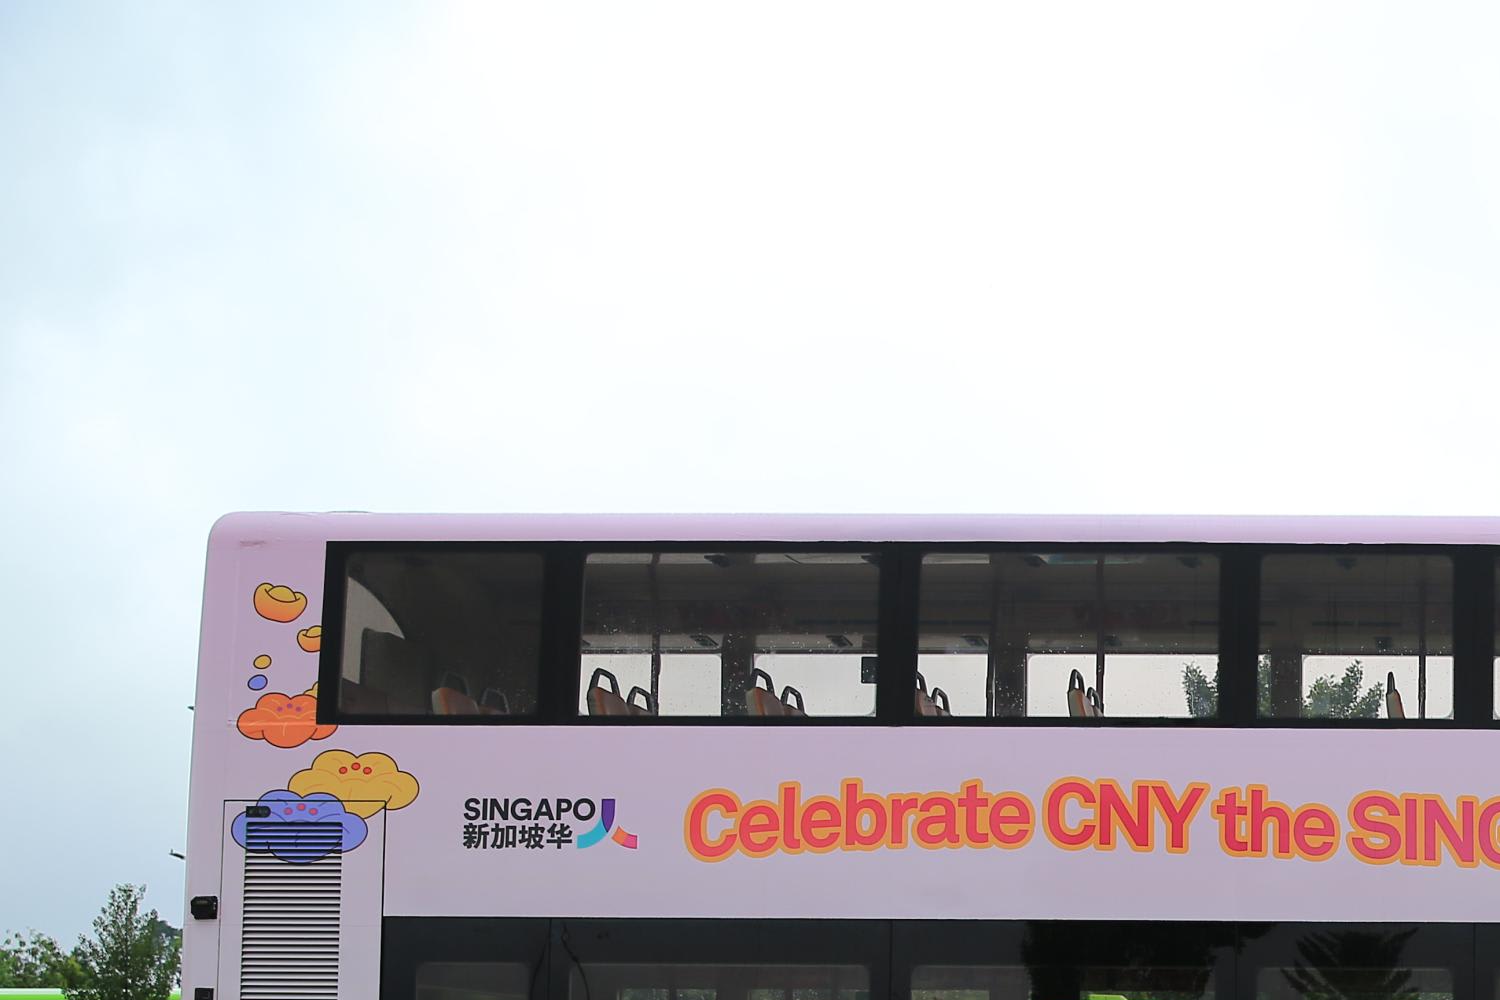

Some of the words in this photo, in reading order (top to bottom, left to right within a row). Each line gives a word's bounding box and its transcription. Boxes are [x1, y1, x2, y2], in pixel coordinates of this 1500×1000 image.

[684, 778, 1035, 863] Celebrate
[1043, 776, 1211, 854] CNY
[1213, 783, 1339, 857] the
